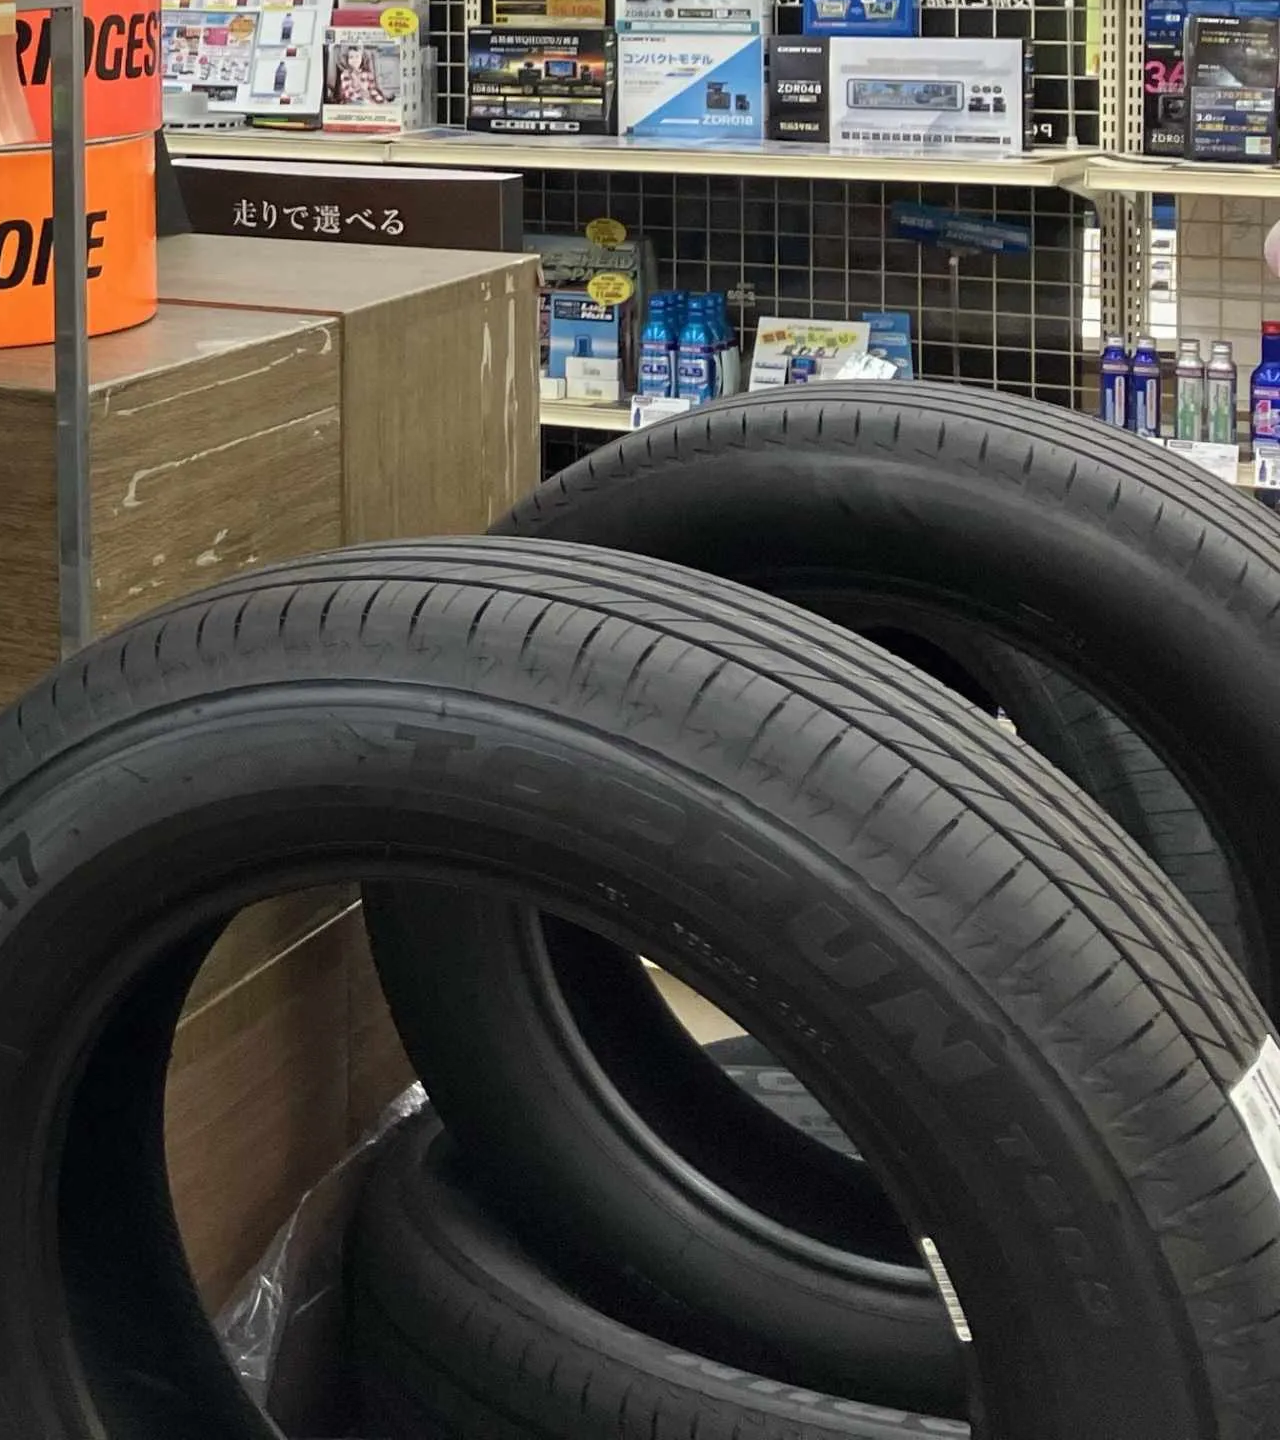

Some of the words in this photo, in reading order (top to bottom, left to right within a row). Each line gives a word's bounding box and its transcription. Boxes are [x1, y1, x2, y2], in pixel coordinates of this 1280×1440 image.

[623, 52, 713, 66] コンパクトモデル
[231, 198, 406, 236] 走りで選べる
